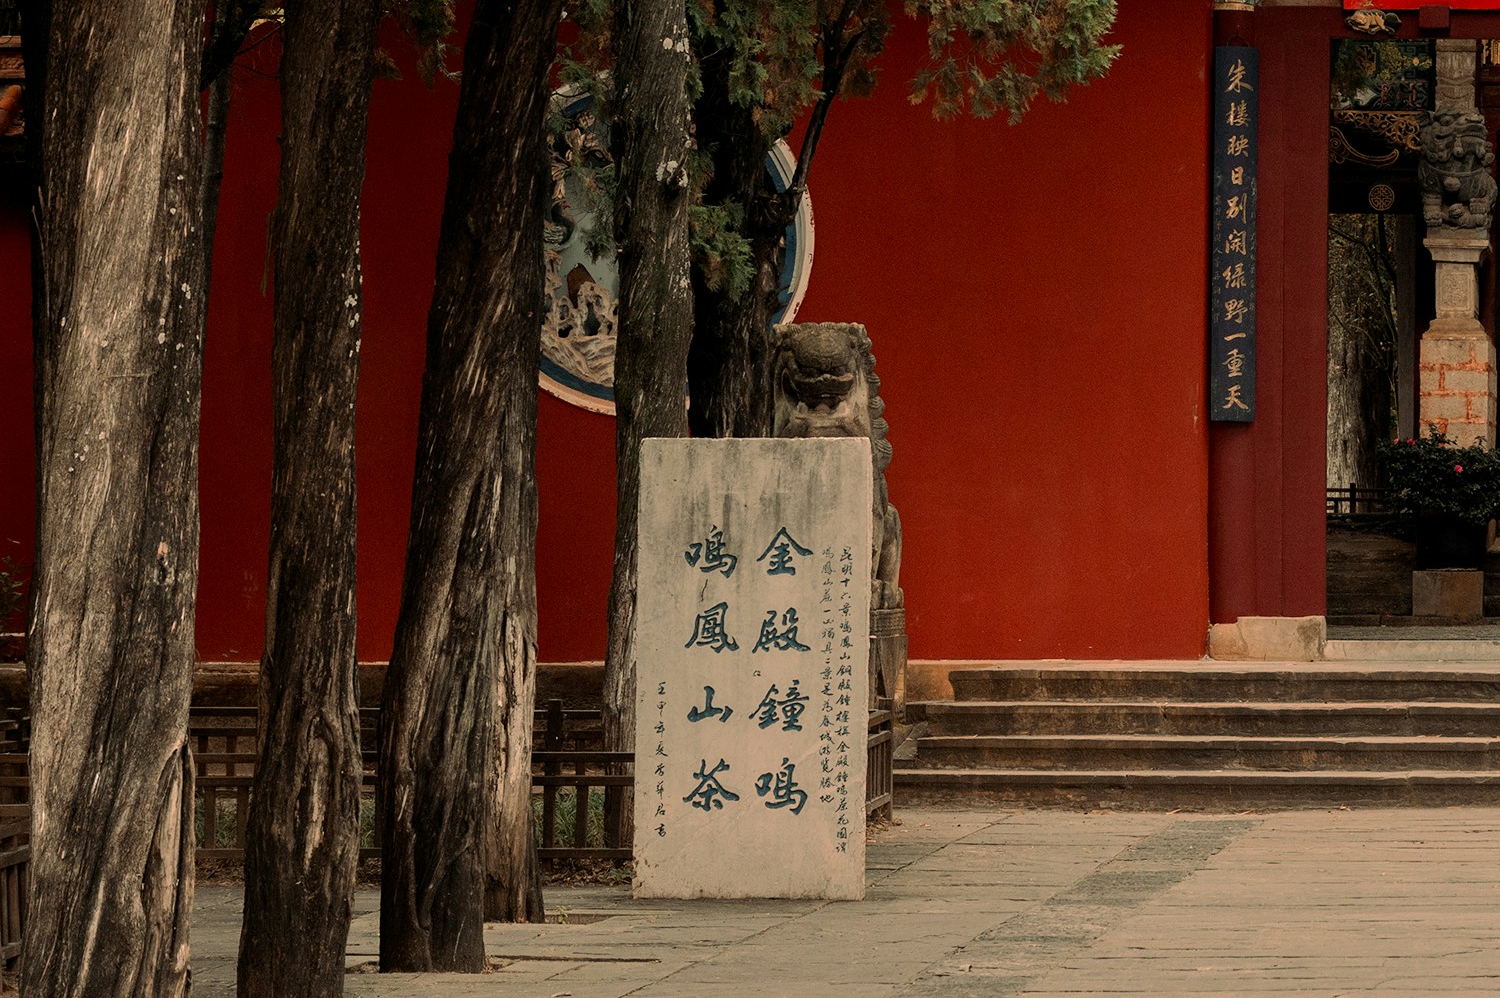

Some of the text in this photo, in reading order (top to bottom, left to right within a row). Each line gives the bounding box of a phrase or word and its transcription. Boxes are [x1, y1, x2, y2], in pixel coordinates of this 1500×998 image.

[683, 525, 740, 813] 鳴鳳山茶
[749, 526, 813, 816] 金殿鐘鳴
